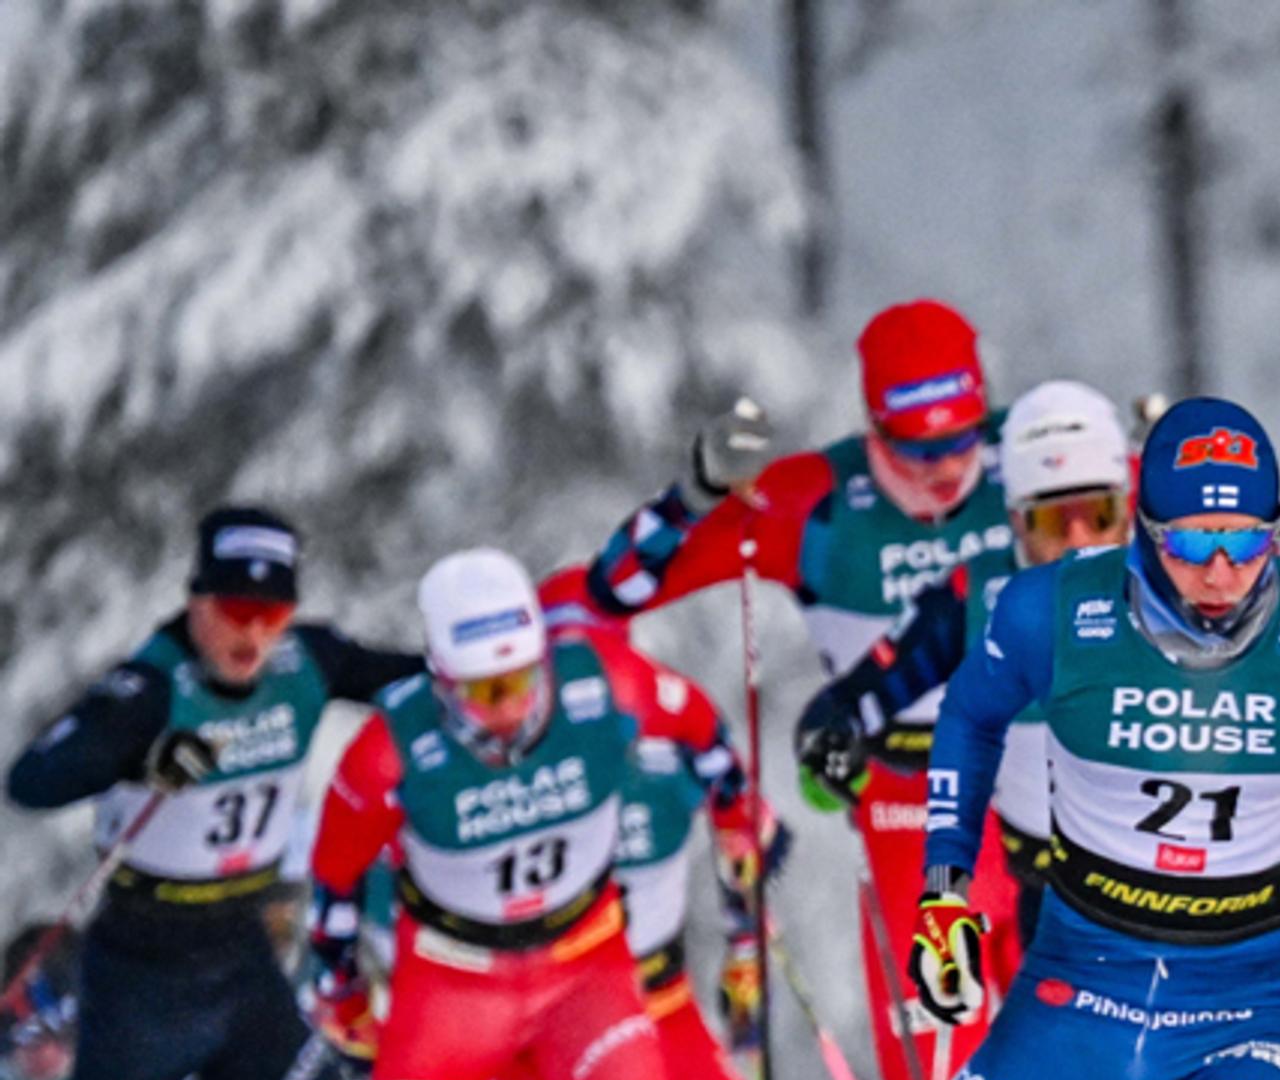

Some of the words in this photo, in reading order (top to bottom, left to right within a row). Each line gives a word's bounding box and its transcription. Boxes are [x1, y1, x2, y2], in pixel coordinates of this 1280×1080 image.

[1111, 686, 1277, 722] POLAR
[1107, 720, 1277, 755] HOUSE
[1134, 778, 1242, 843] 21
[488, 837, 570, 892] 13
[1084, 872, 1275, 918] FINNFORM
